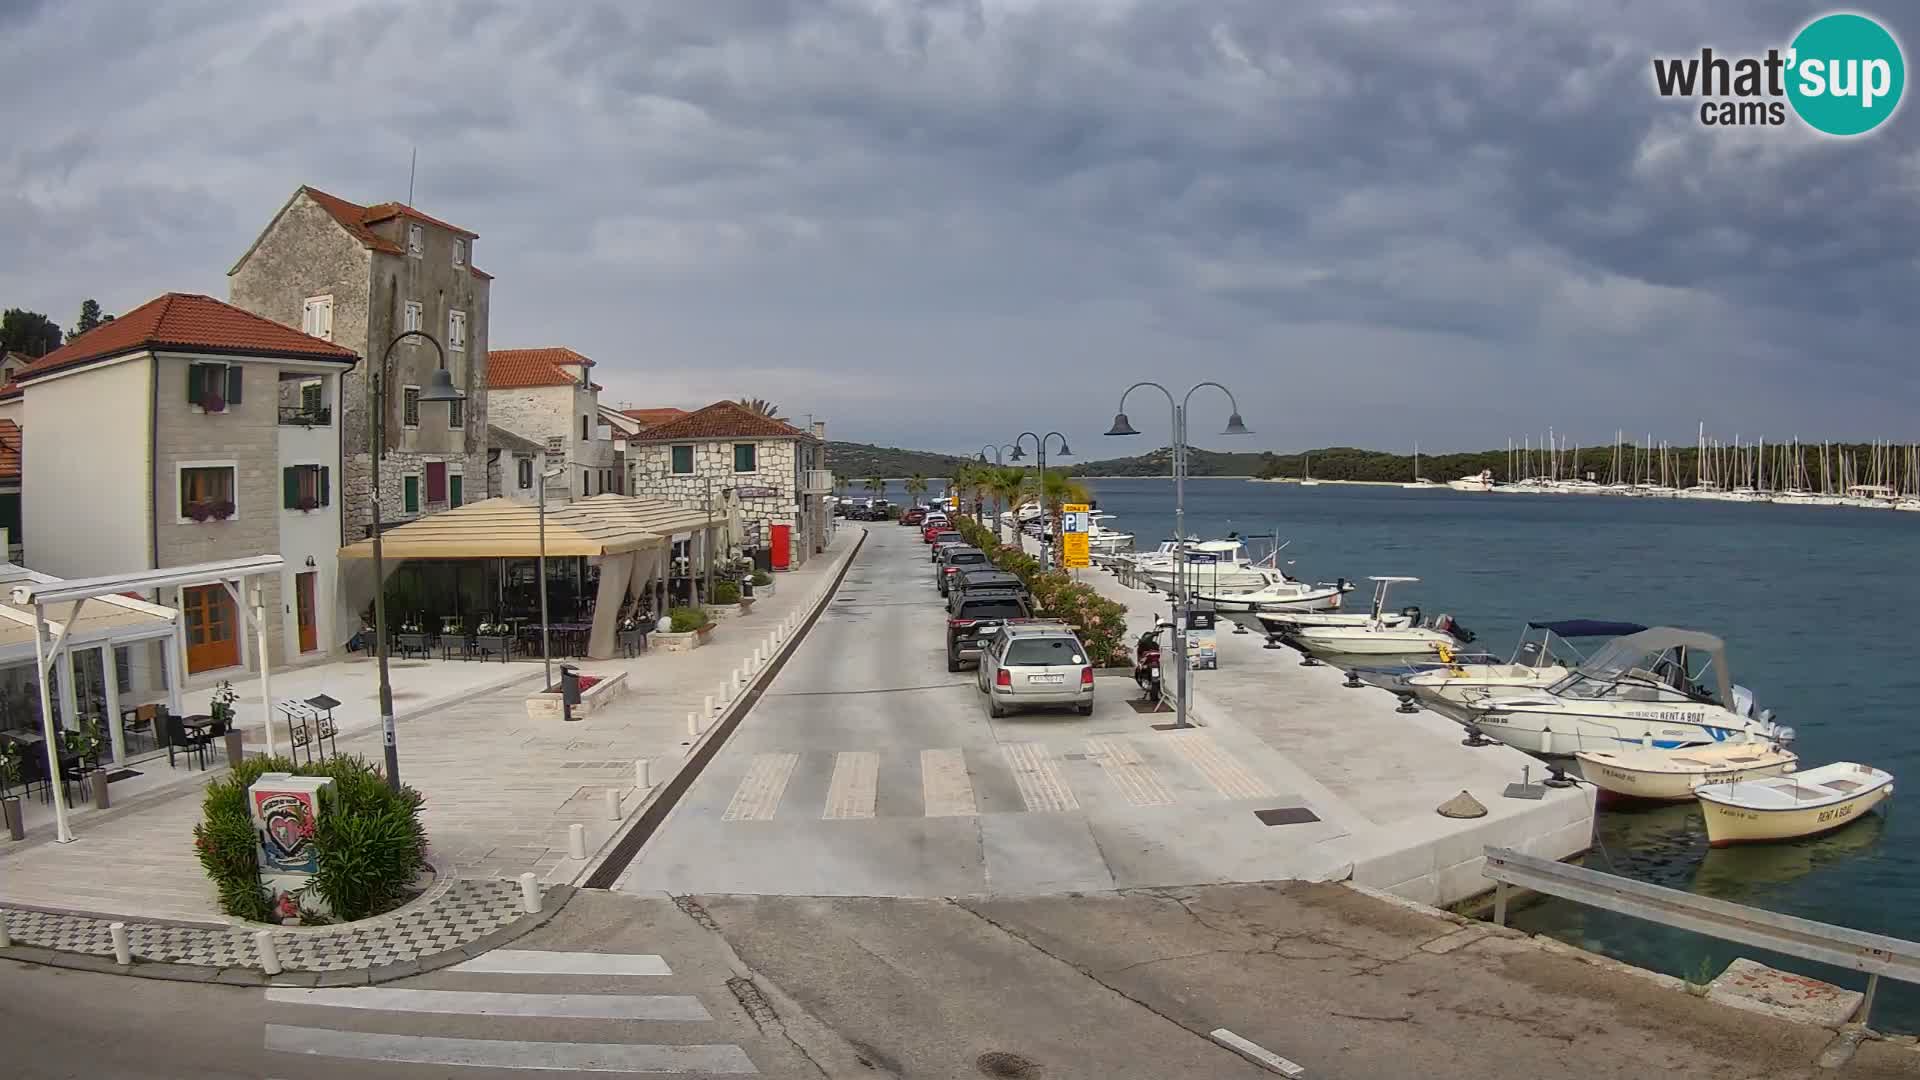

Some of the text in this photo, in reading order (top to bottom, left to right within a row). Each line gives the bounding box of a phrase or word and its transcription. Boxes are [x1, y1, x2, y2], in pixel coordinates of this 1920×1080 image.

[1065, 514, 1075, 531] P
[1659, 711, 1680, 721] RENT
[1680, 712, 1686, 721] A
[1687, 712, 1705, 723] BOAT
[1817, 809, 1834, 823] RENT
